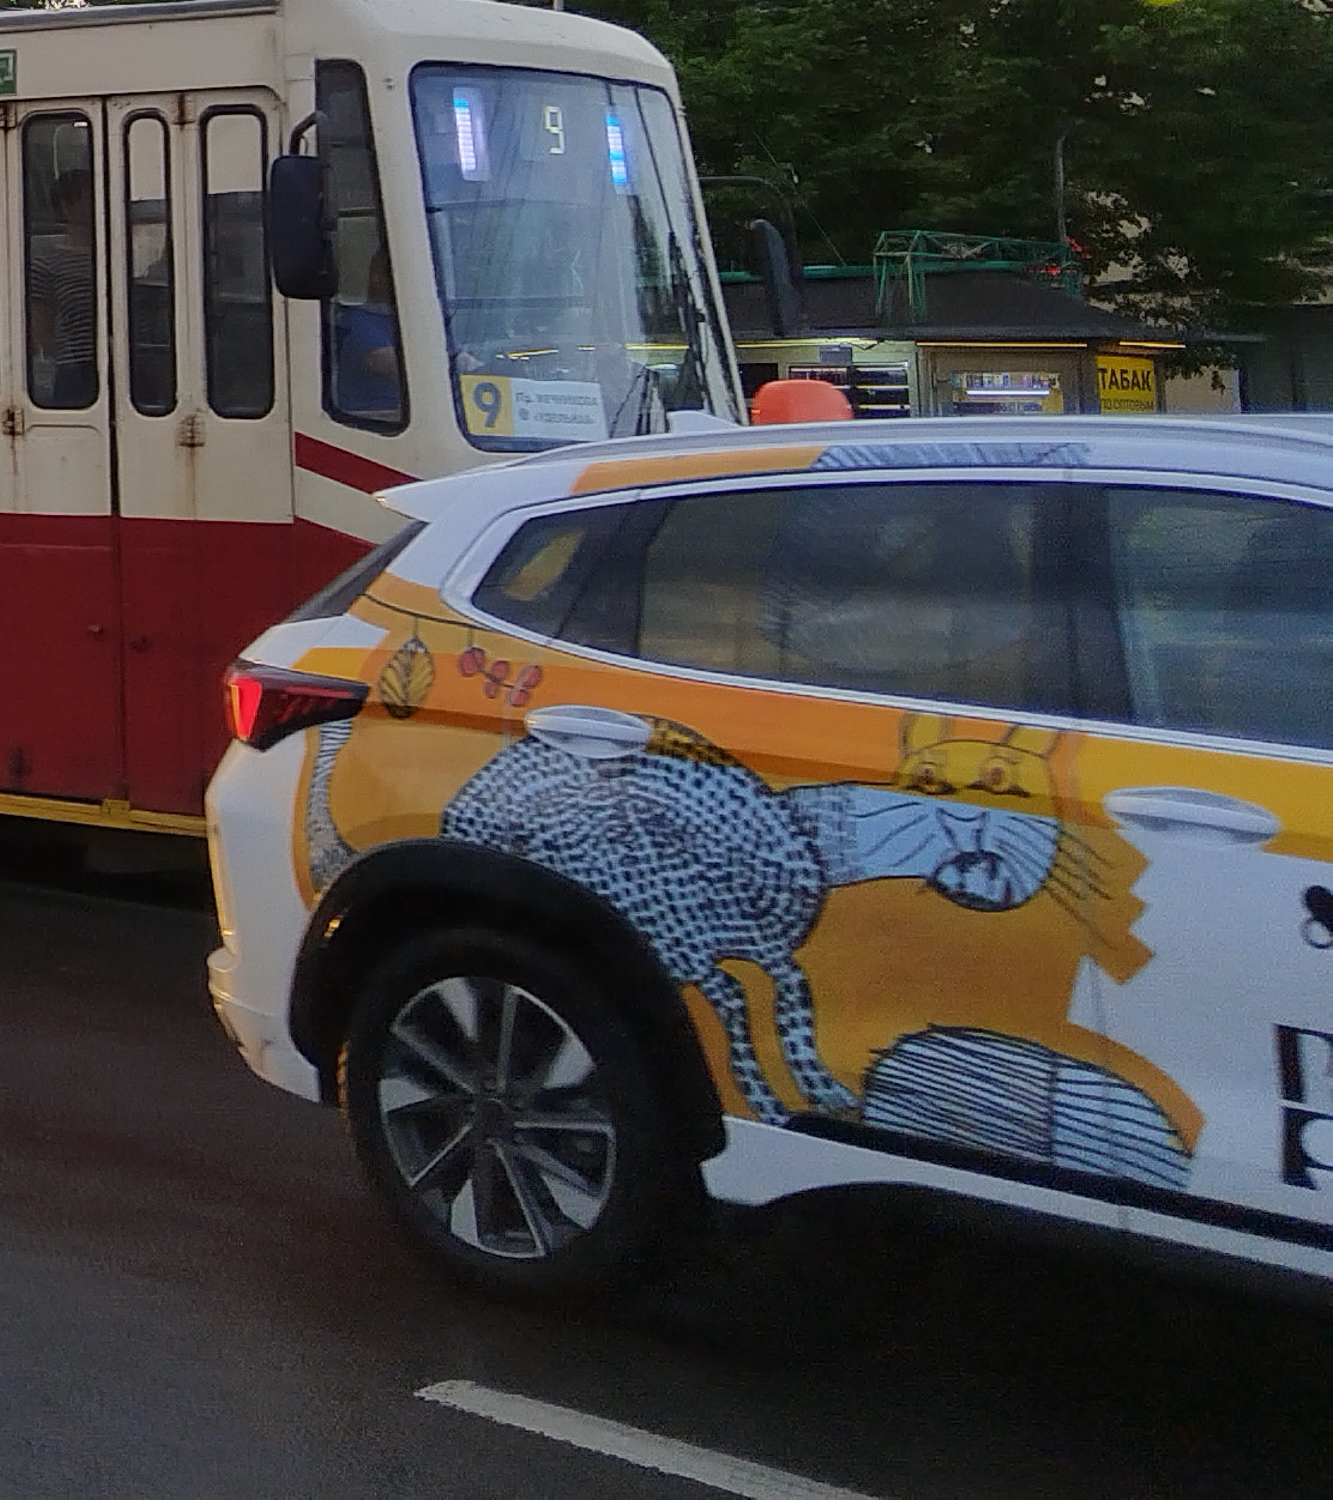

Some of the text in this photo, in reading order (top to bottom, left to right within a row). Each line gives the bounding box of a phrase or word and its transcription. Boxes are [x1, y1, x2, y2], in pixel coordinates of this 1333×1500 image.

[544, 105, 566, 155] 9
[1097, 367, 1152, 392] ТАБАК
[473, 381, 502, 429] 9
